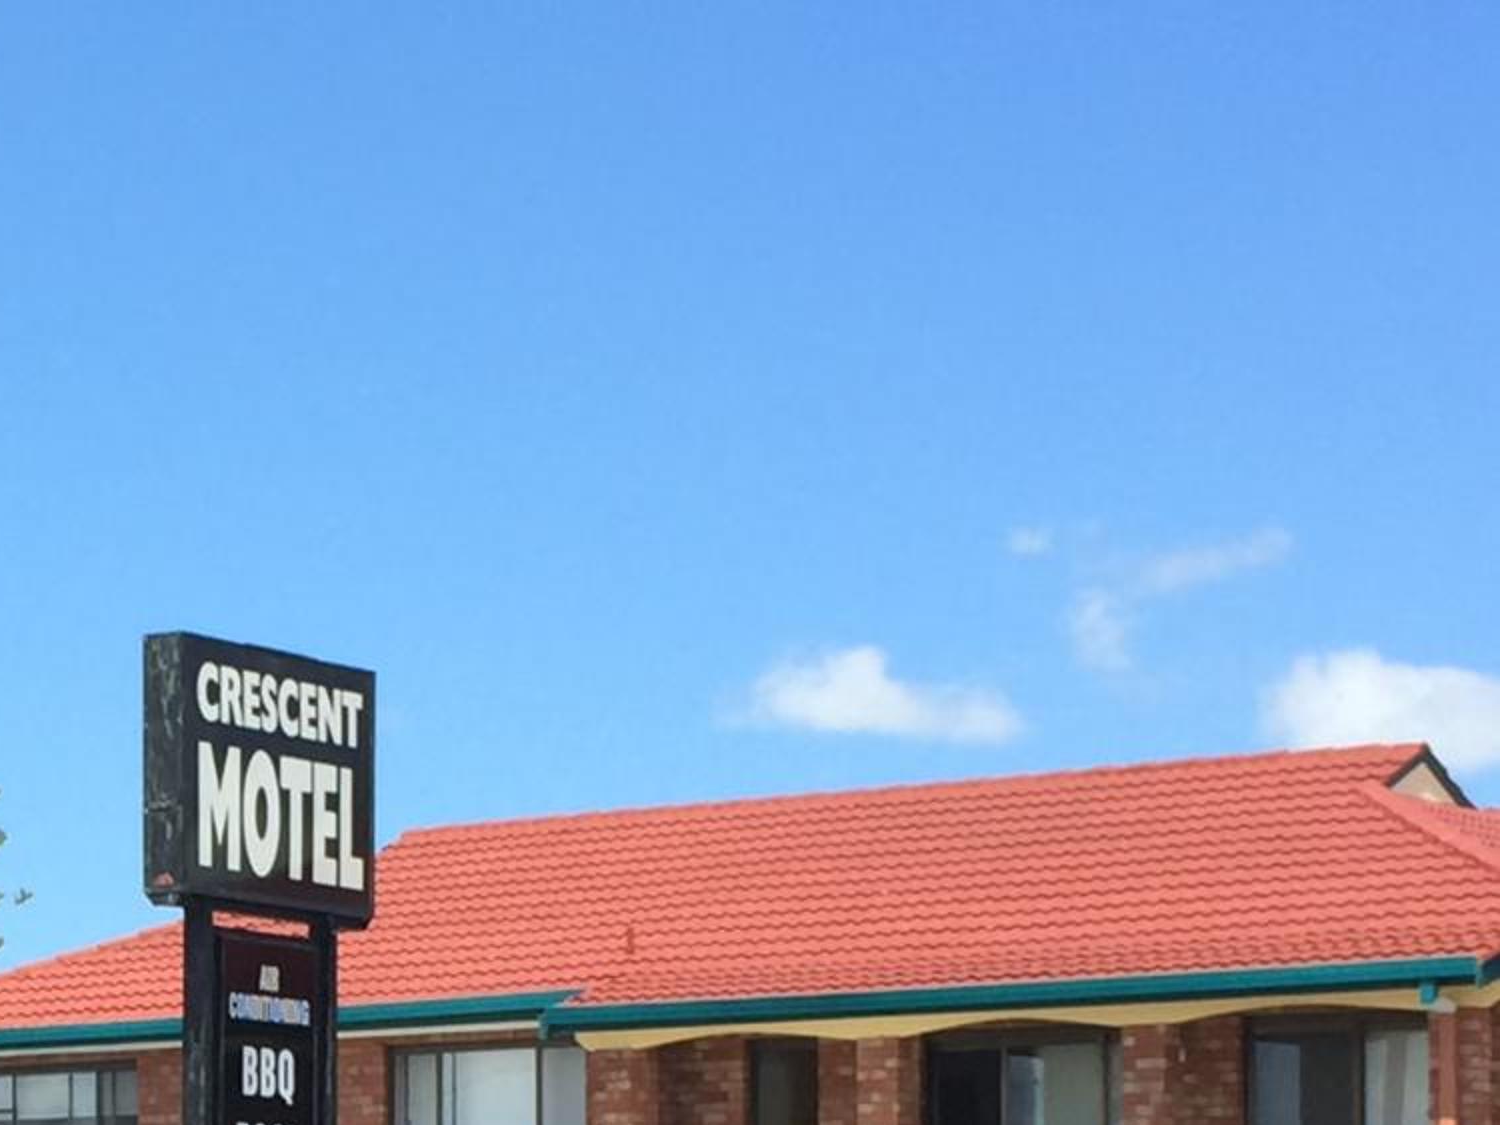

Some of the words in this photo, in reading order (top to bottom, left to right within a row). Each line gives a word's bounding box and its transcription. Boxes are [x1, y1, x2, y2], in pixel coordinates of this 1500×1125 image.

[197, 661, 363, 748] CRESCENT
[198, 741, 364, 891] MOTEL
[242, 1046, 295, 1105] BBQ
